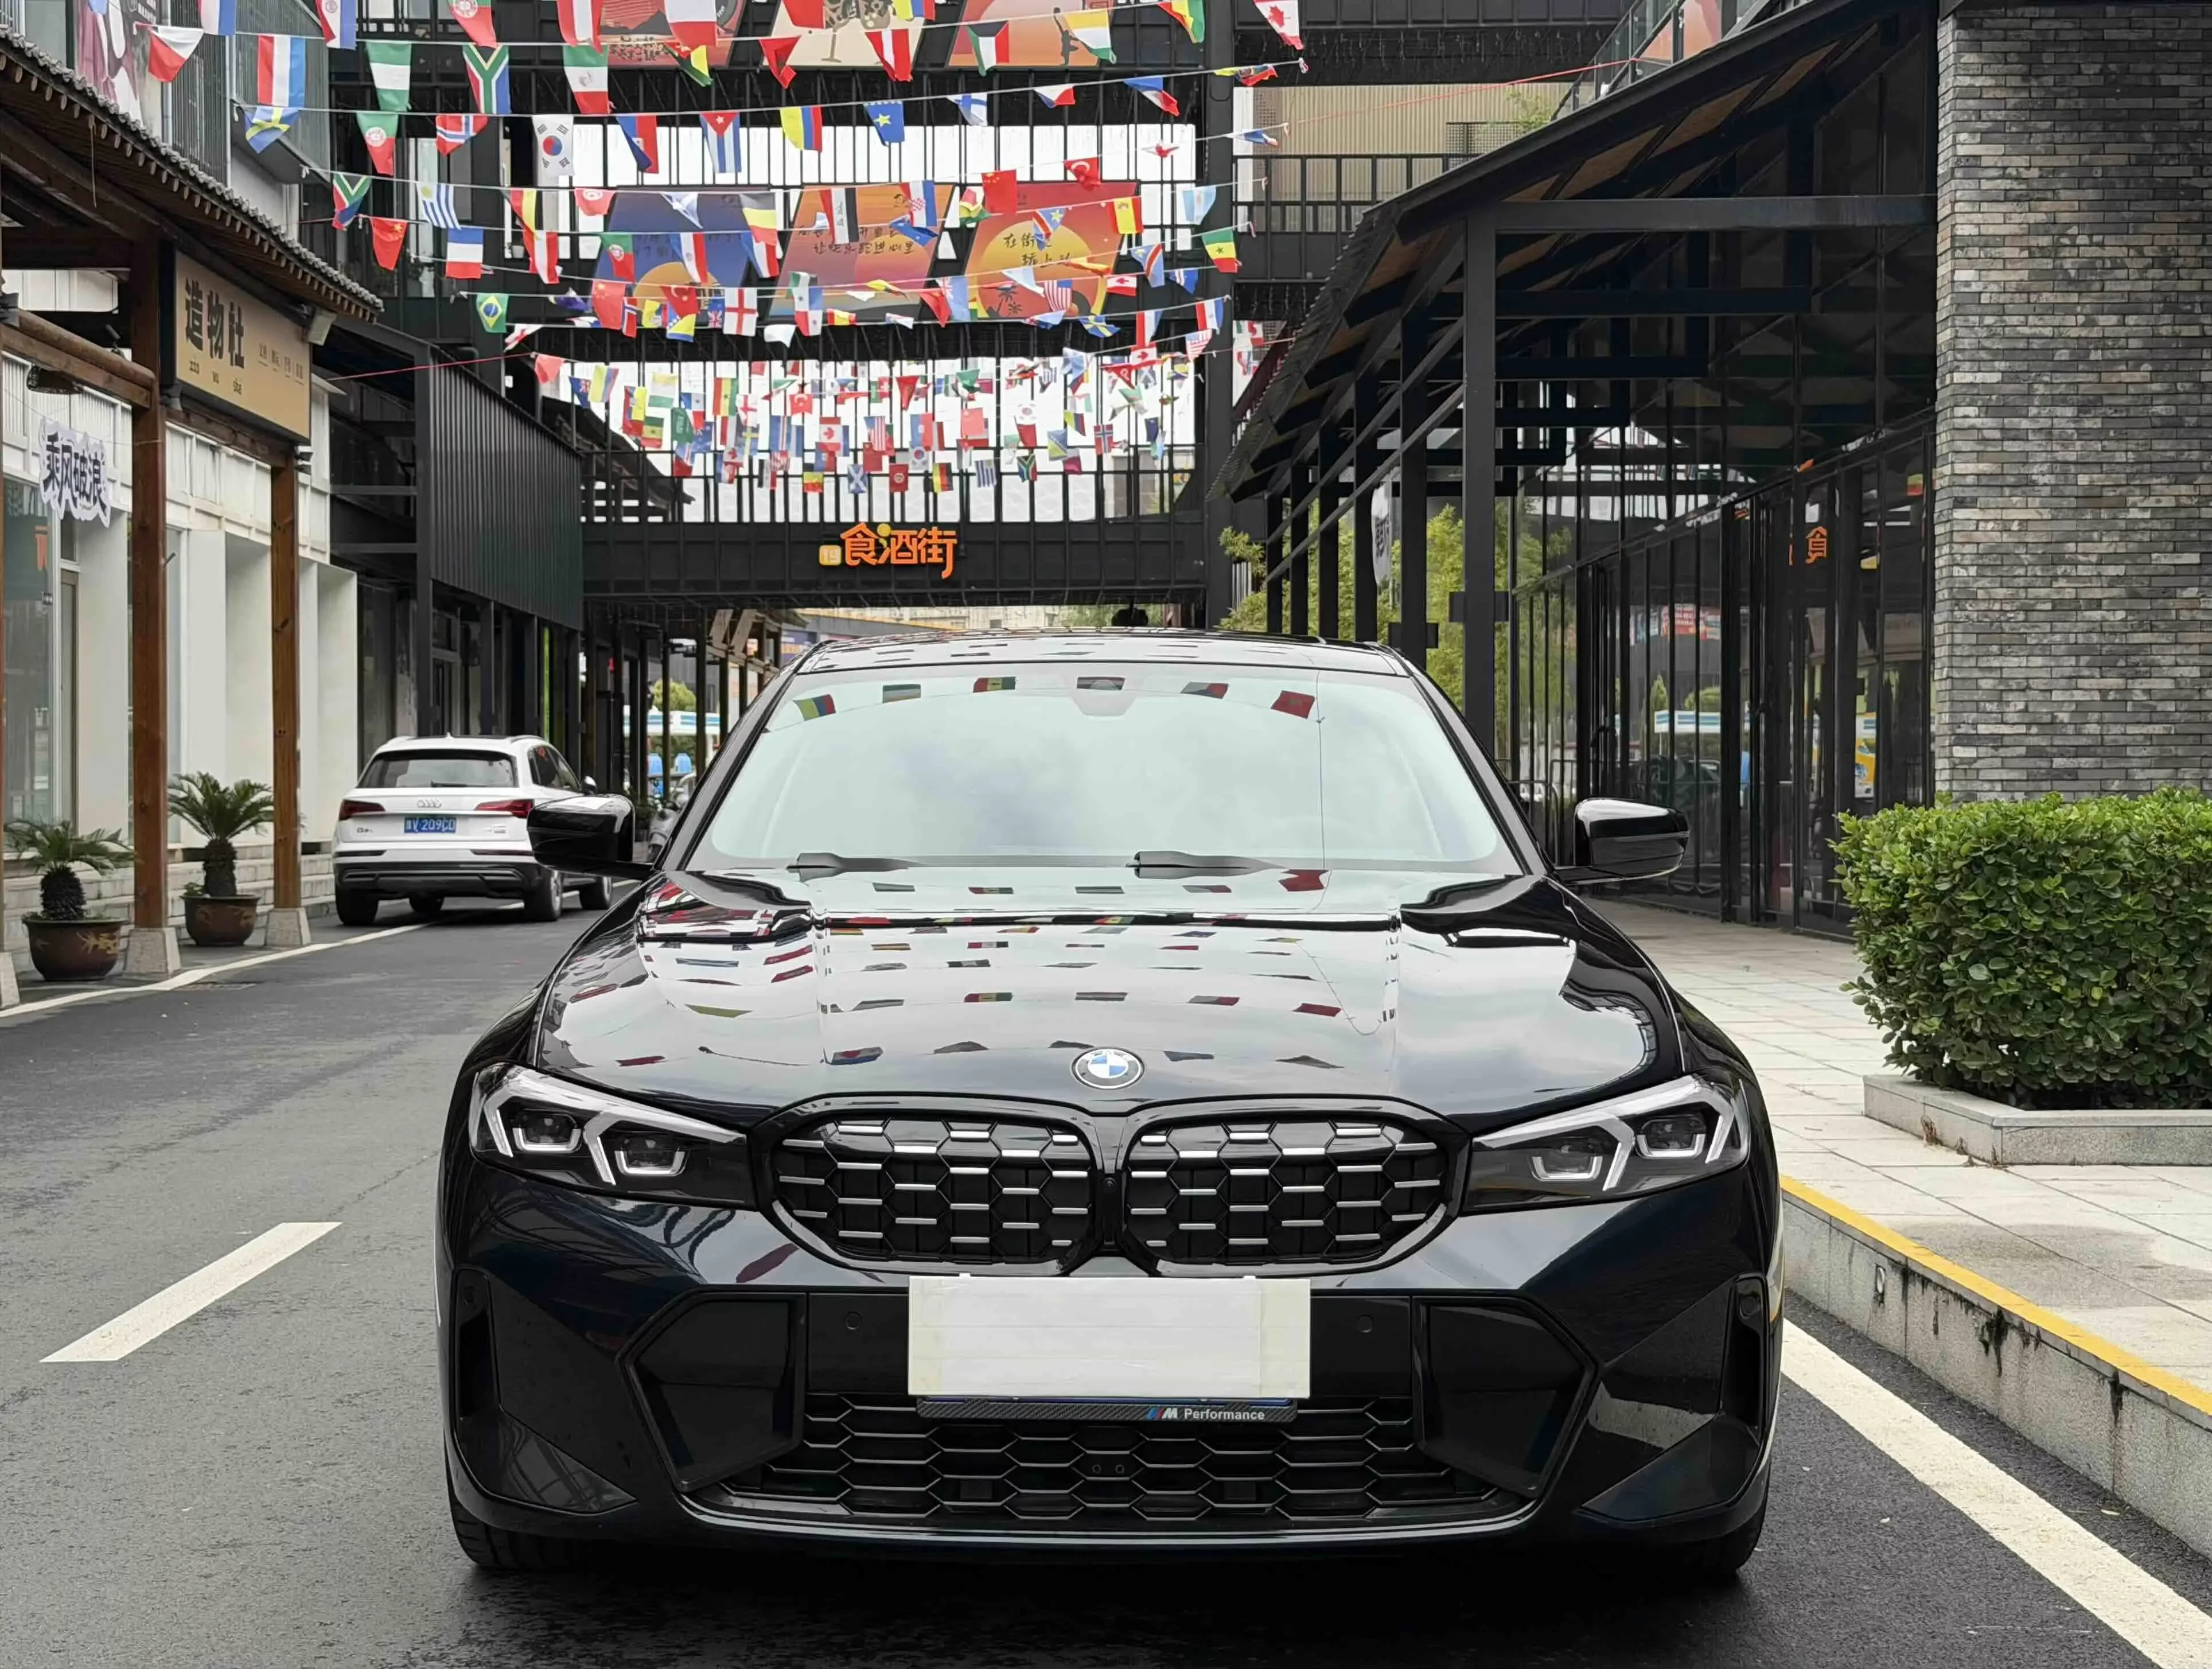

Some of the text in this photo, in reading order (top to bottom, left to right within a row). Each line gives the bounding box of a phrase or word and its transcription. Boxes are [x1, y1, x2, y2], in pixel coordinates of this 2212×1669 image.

[185, 275, 244, 369] 造物社
[43, 431, 107, 516] 乘风破浪
[840, 523, 957, 579] 食酒街
[1160, 1407, 1265, 1420] M Performance
